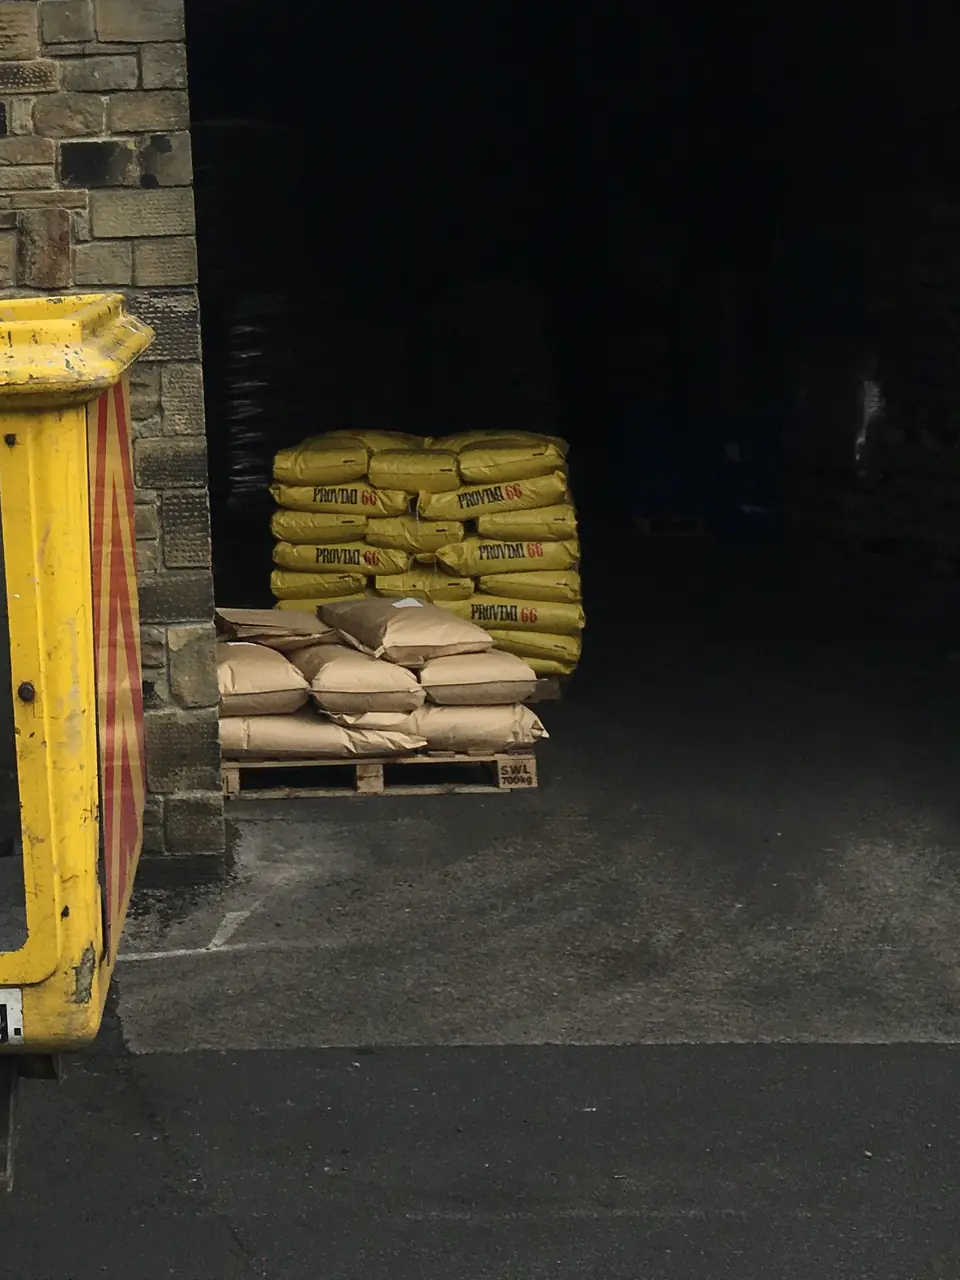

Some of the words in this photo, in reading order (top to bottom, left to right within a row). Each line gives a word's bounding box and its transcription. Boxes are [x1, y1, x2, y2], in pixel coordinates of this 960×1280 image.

[313, 488, 358, 505] PROVIMI
[458, 486, 504, 509] PROVIMI
[504, 483, 522, 499] 66
[316, 548, 361, 565] PROVIMI
[478, 543, 526, 561] PROVIMI
[527, 543, 544, 558] 66
[471, 604, 518, 622] PROVIMI
[521, 607, 538, 624] 66
[500, 764, 531, 776] SWL
